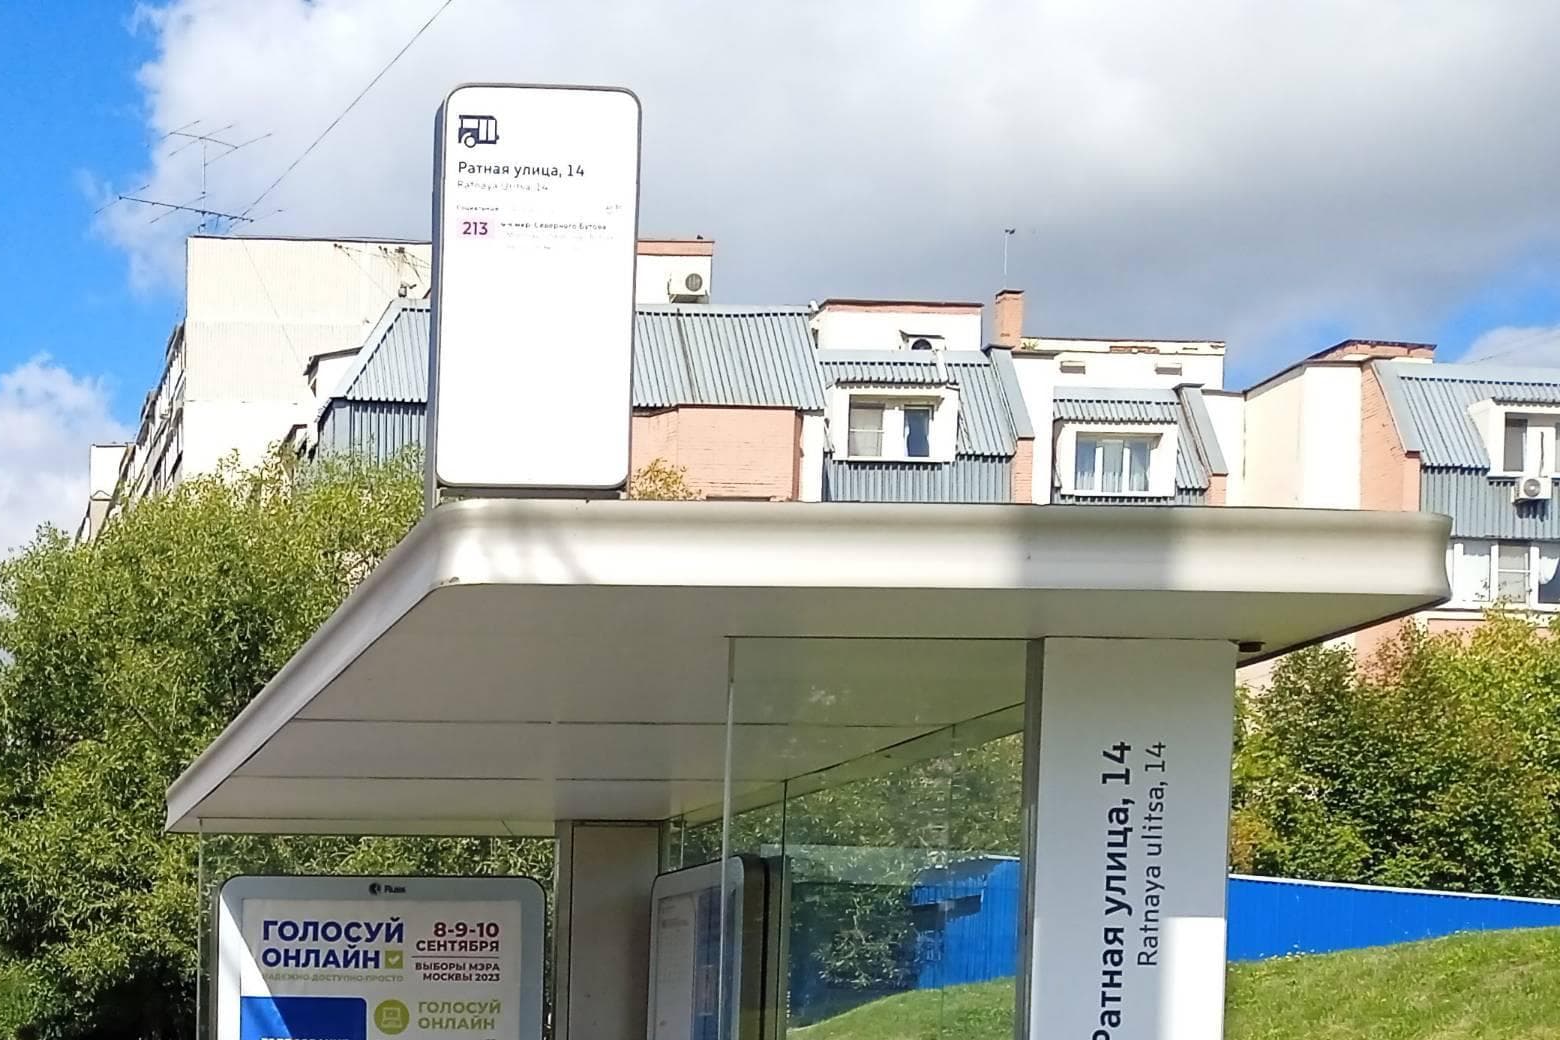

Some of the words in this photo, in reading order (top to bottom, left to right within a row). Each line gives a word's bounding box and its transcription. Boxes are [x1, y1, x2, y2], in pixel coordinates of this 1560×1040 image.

[458, 161, 509, 175] Ратная
[514, 164, 562, 178] улица,
[567, 164, 585, 177] 14
[462, 221, 488, 235] 213
[1102, 741, 1132, 786] 14
[1145, 741, 1167, 773] 14
[1141, 781, 1168, 857] ulitsa,
[1104, 798, 1135, 916] улица,
[1137, 865, 1165, 966] Ratnaya
[263, 917, 404, 943] ГОЛОСУЙ
[433, 922, 500, 938] 8-9-10
[416, 940, 500, 953] СЕНТЯБРЯ
[262, 945, 380, 969] ОНЛАЙН
[415, 963, 466, 972] ВЫБОРЫ
[469, 963, 500, 972] МЭРА
[423, 973, 473, 982] МОСКВЫ
[475, 973, 501, 982] 2023
[418, 1000, 501, 1014] ГОЛОСУЙ
[418, 1016, 495, 1030] ОНЛАЙН
